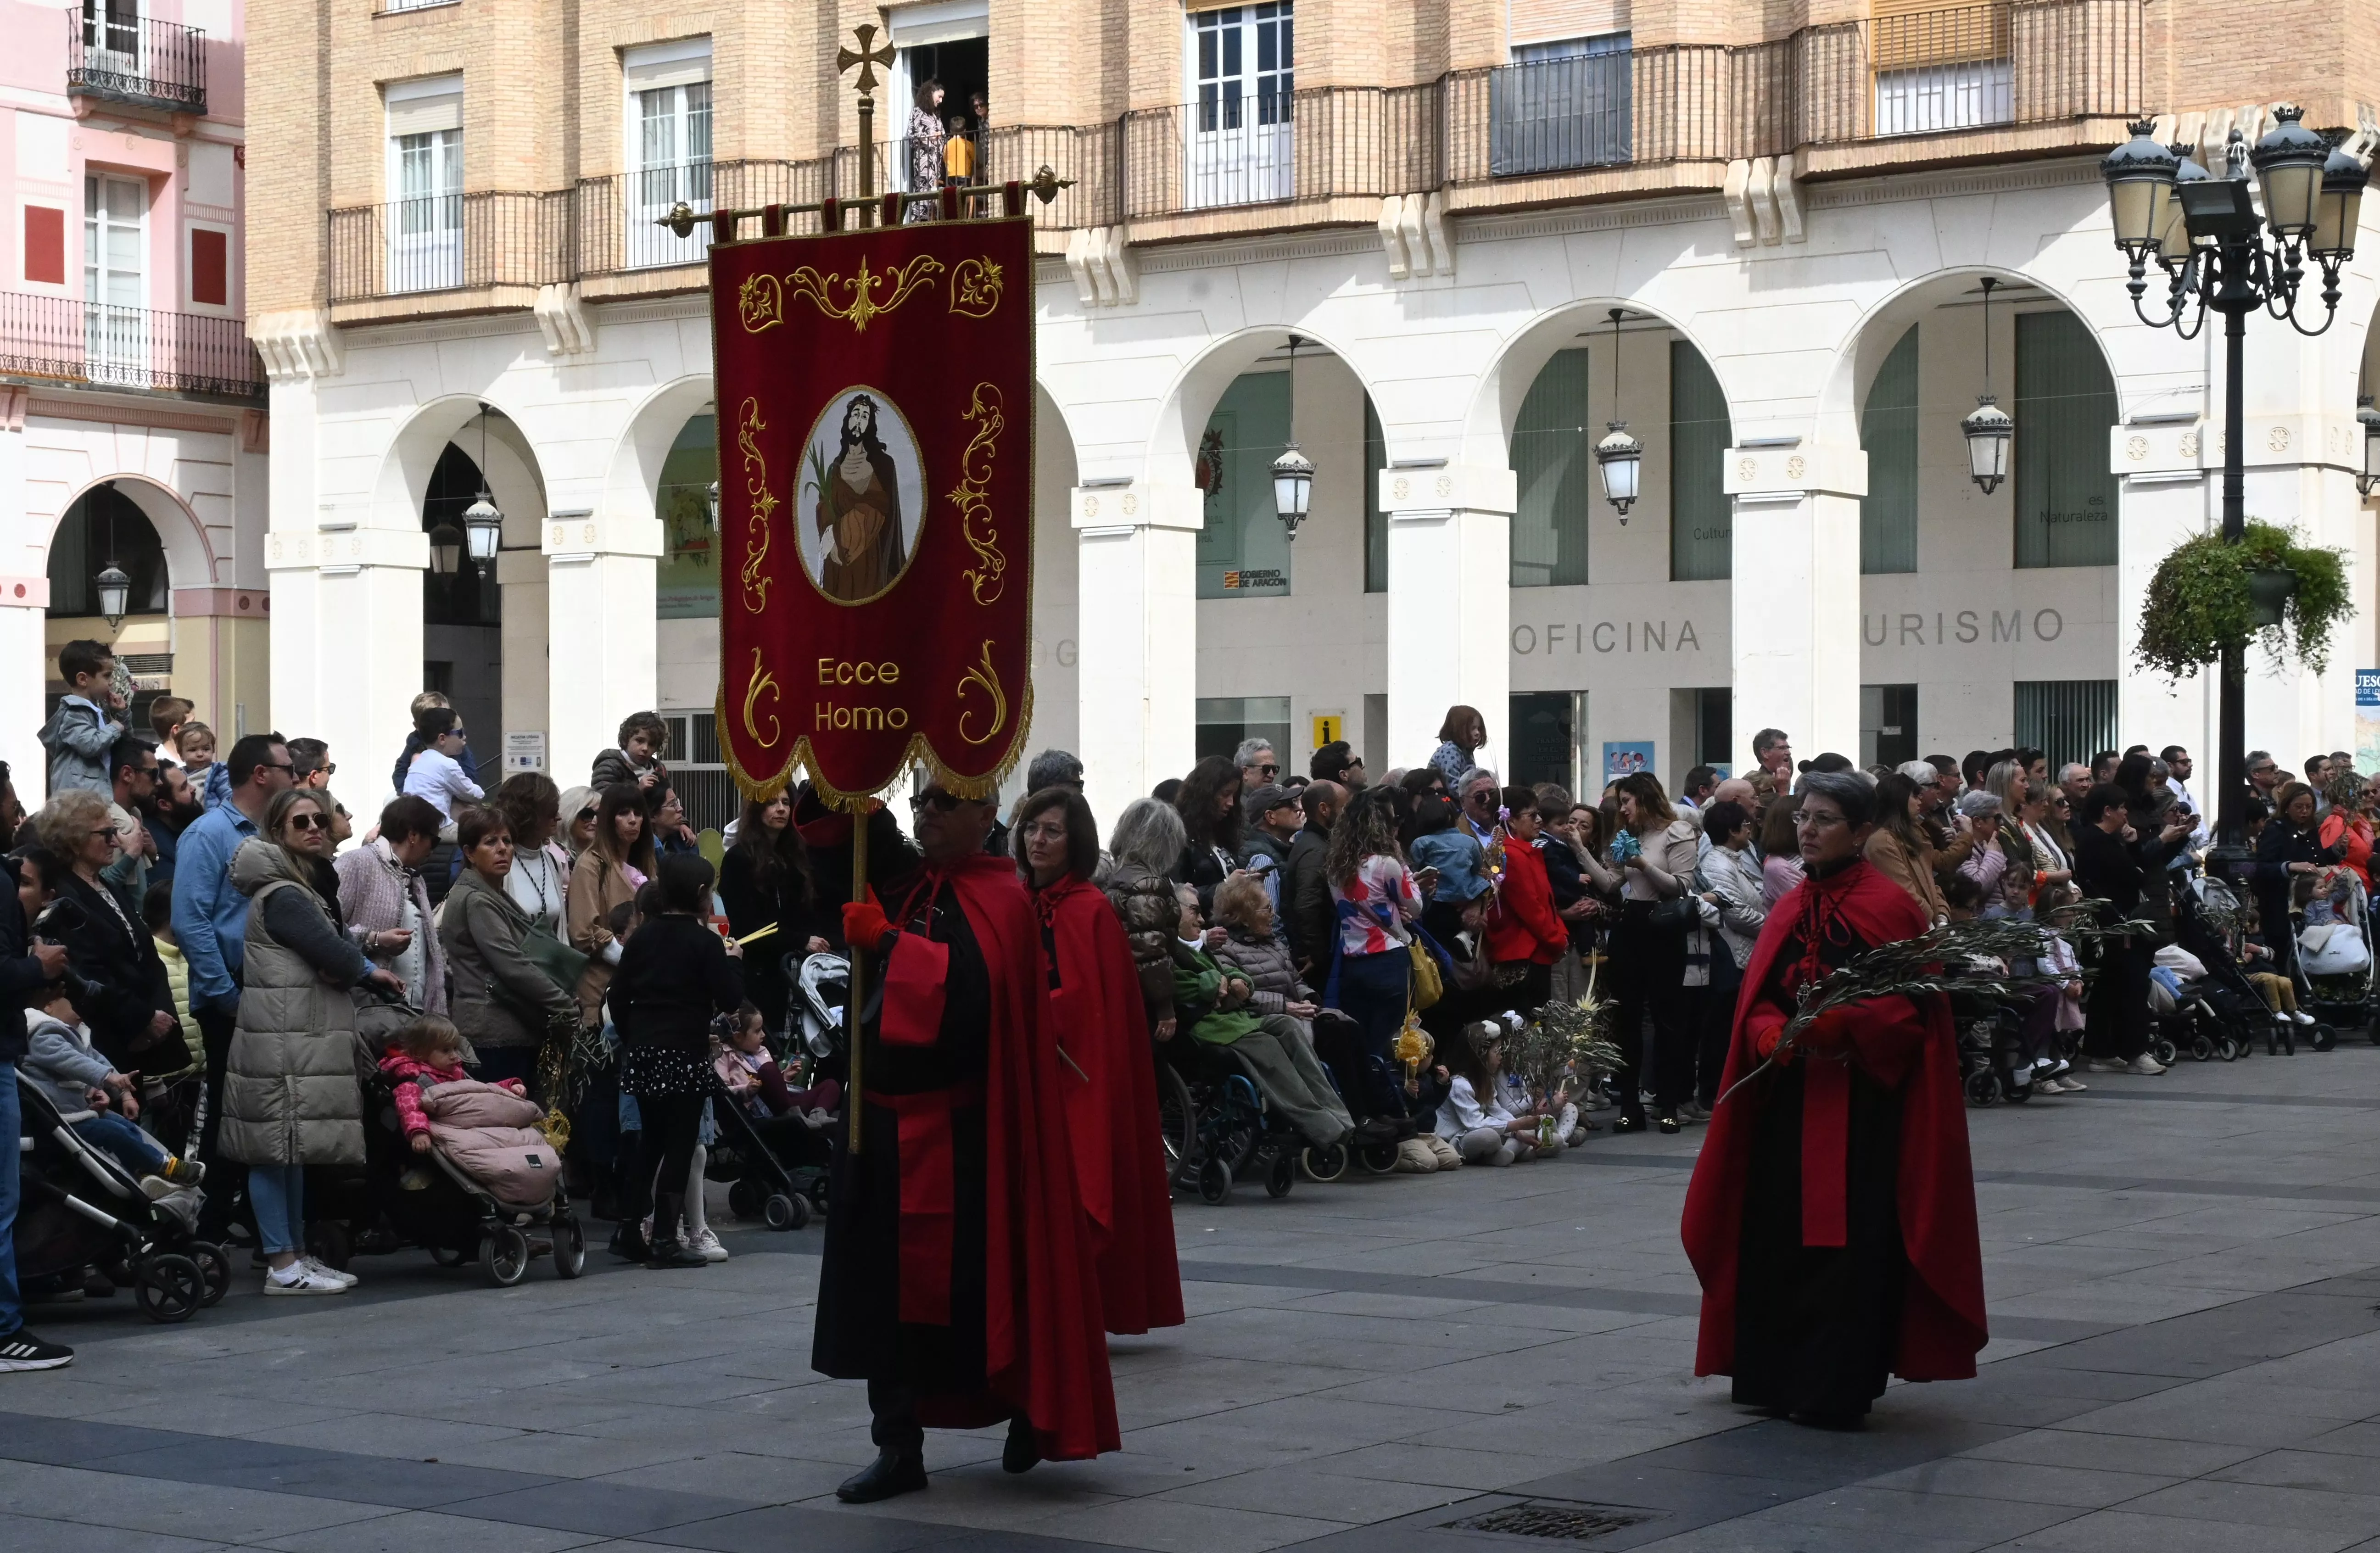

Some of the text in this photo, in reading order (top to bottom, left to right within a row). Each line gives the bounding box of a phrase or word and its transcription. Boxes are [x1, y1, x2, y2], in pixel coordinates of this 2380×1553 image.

[2089, 496, 2104, 505] es
[2040, 509, 2107, 523] Naturaleza
[1694, 527, 1732, 540] Cultur
[1240, 569, 1280, 579] GOBIERNO
[1240, 579, 1250, 587] DE
[1512, 608, 2063, 655] OFICINA URISMO
[818, 658, 899, 686] Ecce
[816, 701, 909, 732] Homo
